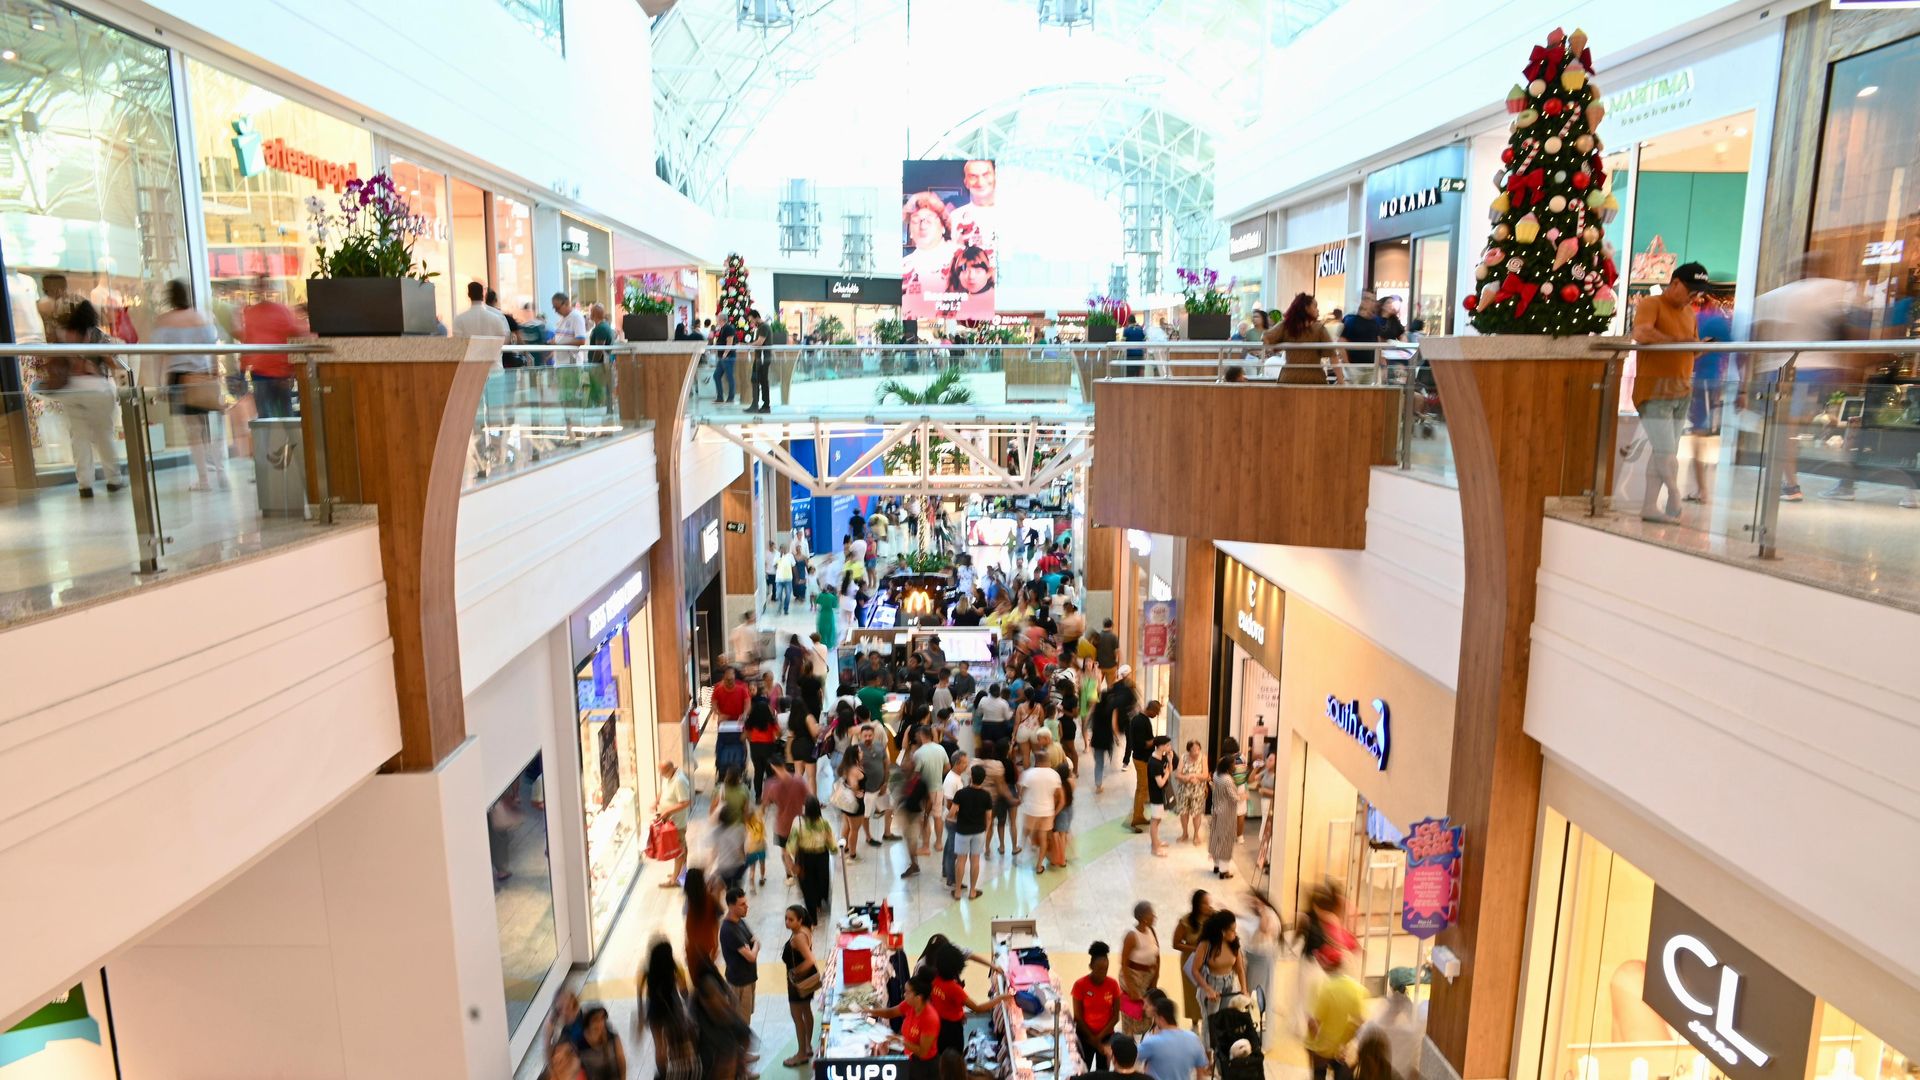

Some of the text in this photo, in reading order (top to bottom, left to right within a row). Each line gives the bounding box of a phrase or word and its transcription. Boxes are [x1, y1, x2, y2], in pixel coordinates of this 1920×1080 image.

[1379, 187, 1436, 219] MORANA
[1415, 822, 1441, 836] ICE
[1662, 934, 1769, 1067] CL
[827, 1064, 897, 1080] LUPO
